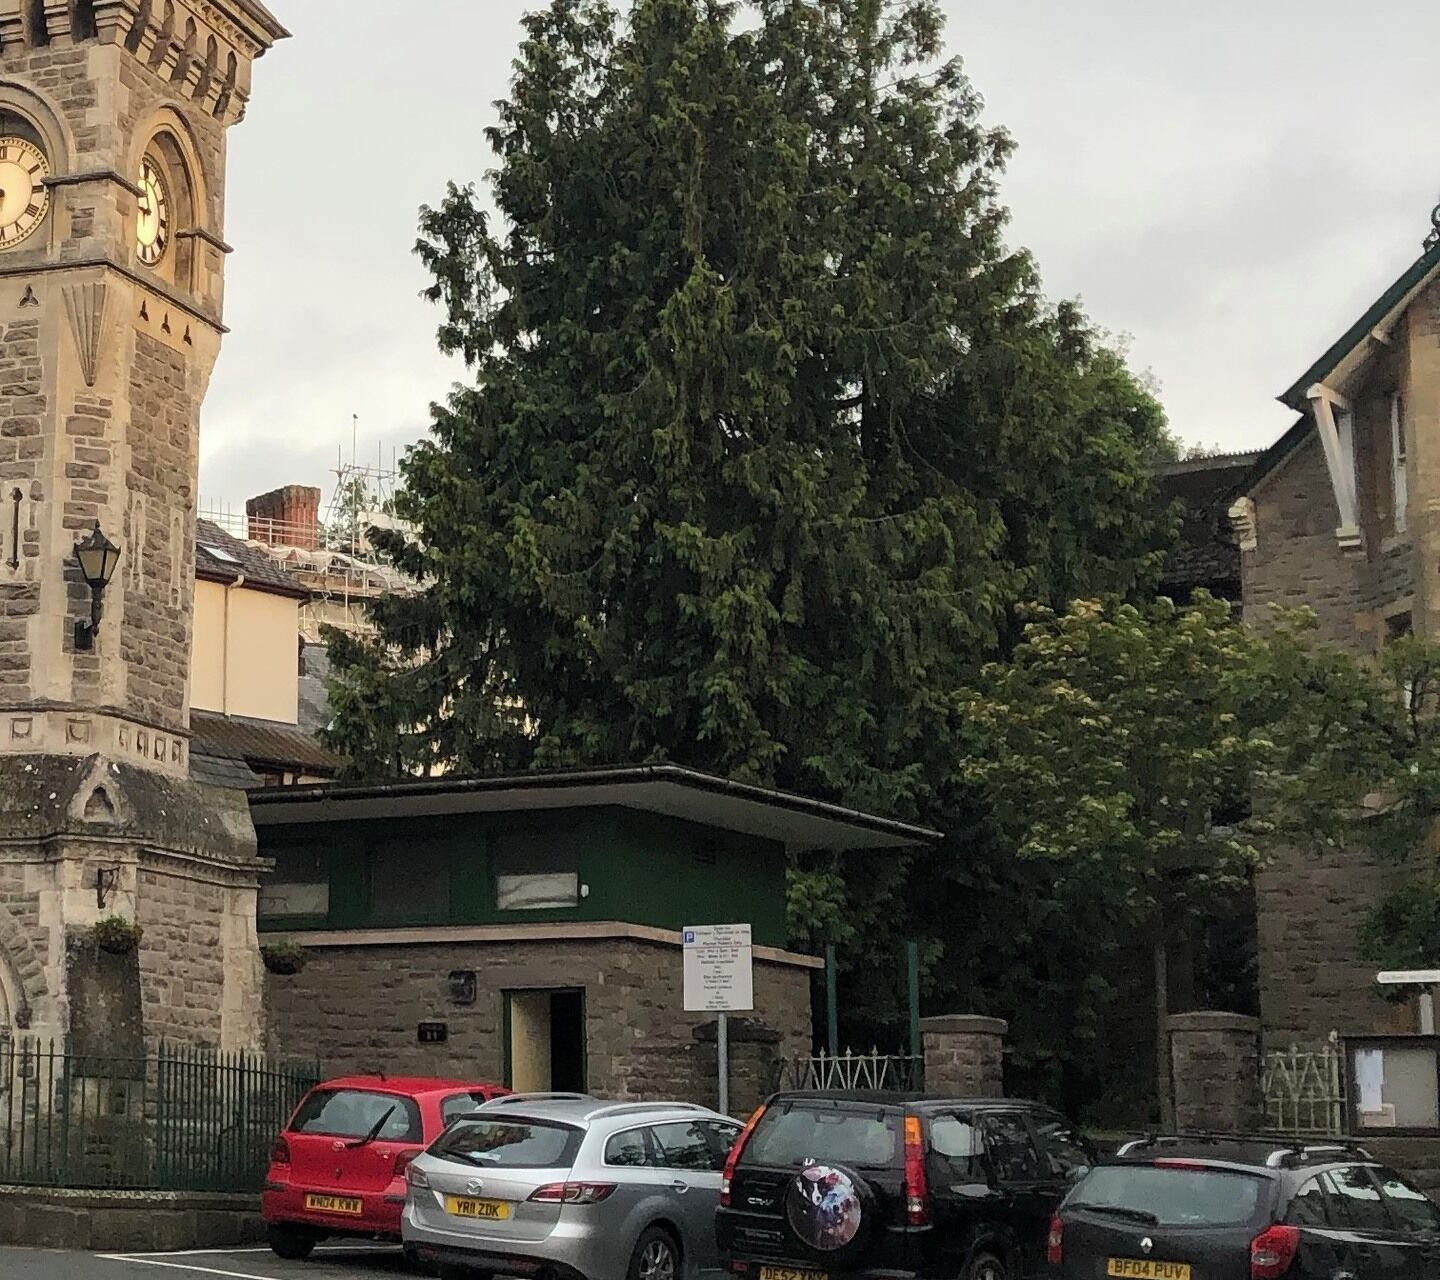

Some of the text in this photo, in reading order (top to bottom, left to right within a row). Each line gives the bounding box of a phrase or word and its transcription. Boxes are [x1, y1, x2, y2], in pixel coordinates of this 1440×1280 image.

[456, 1200, 500, 1217] YR11 ZDK
[1114, 1261, 1183, 1279] BF04 PUV
